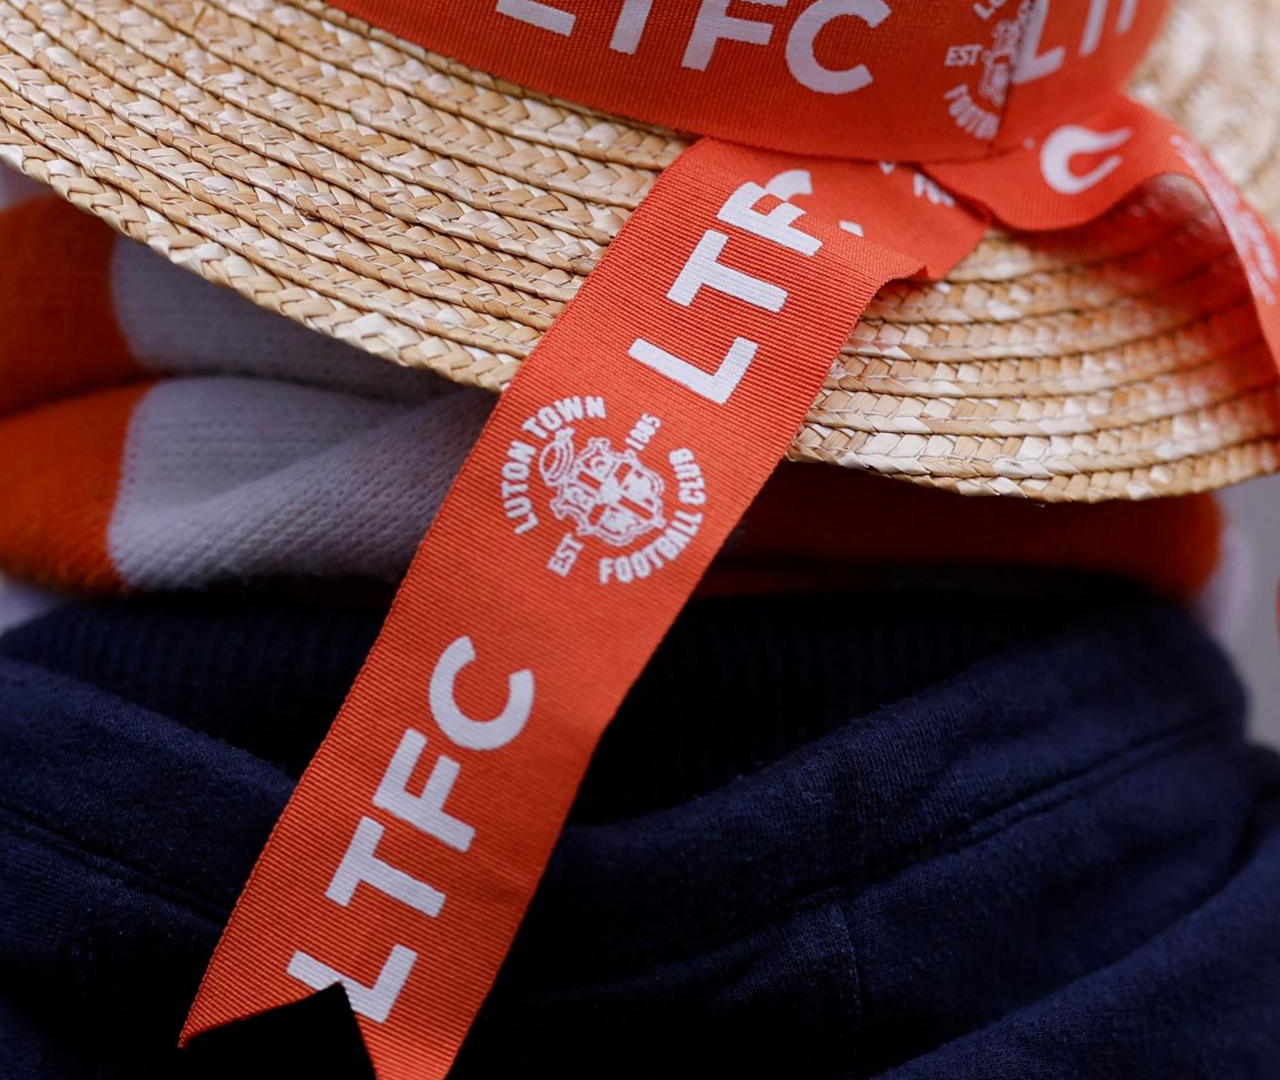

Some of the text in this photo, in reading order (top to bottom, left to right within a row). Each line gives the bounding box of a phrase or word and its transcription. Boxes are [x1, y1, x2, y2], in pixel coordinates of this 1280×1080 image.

[944, 43, 983, 67] EST
[500, 395, 607, 536] LUTON TOWN
[598, 447, 708, 585] FOOTBALL CLUB
[546, 532, 585, 577] EST
[286, 634, 535, 1023] LTFC
